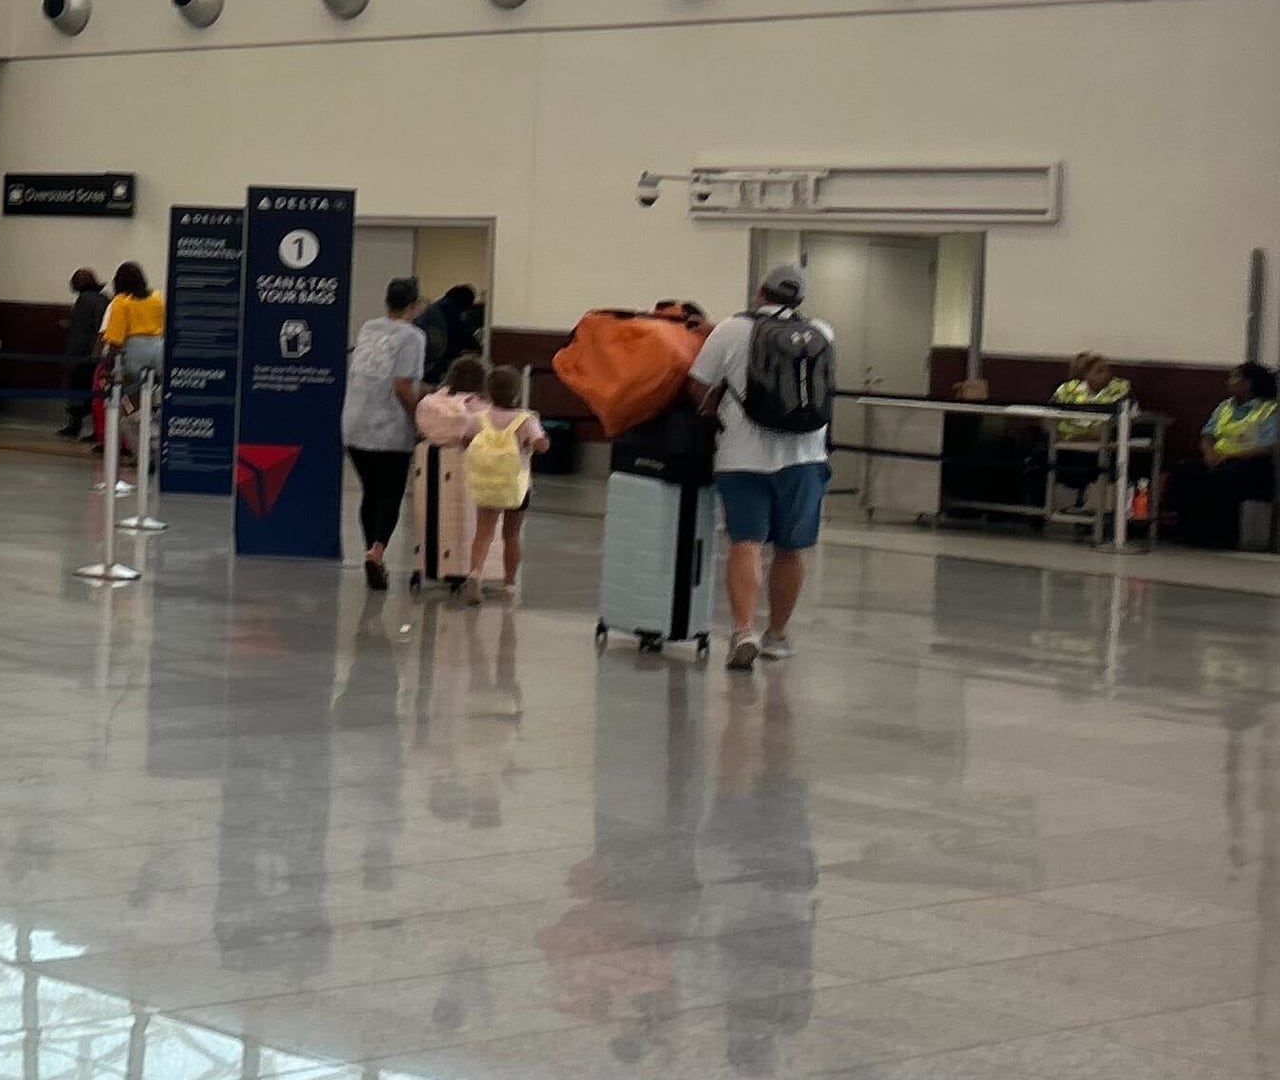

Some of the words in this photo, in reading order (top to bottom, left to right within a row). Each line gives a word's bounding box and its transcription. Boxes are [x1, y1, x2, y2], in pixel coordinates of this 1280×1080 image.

[24, 187, 76, 202] Oversized
[274, 196, 330, 211] DELTA
[192, 213, 233, 225] DELTA
[292, 237, 304, 261] 1
[256, 275, 295, 290] SCAN
[307, 277, 339, 291] TAG
[258, 290, 298, 303] YOUR
[298, 291, 336, 305] BAGS
